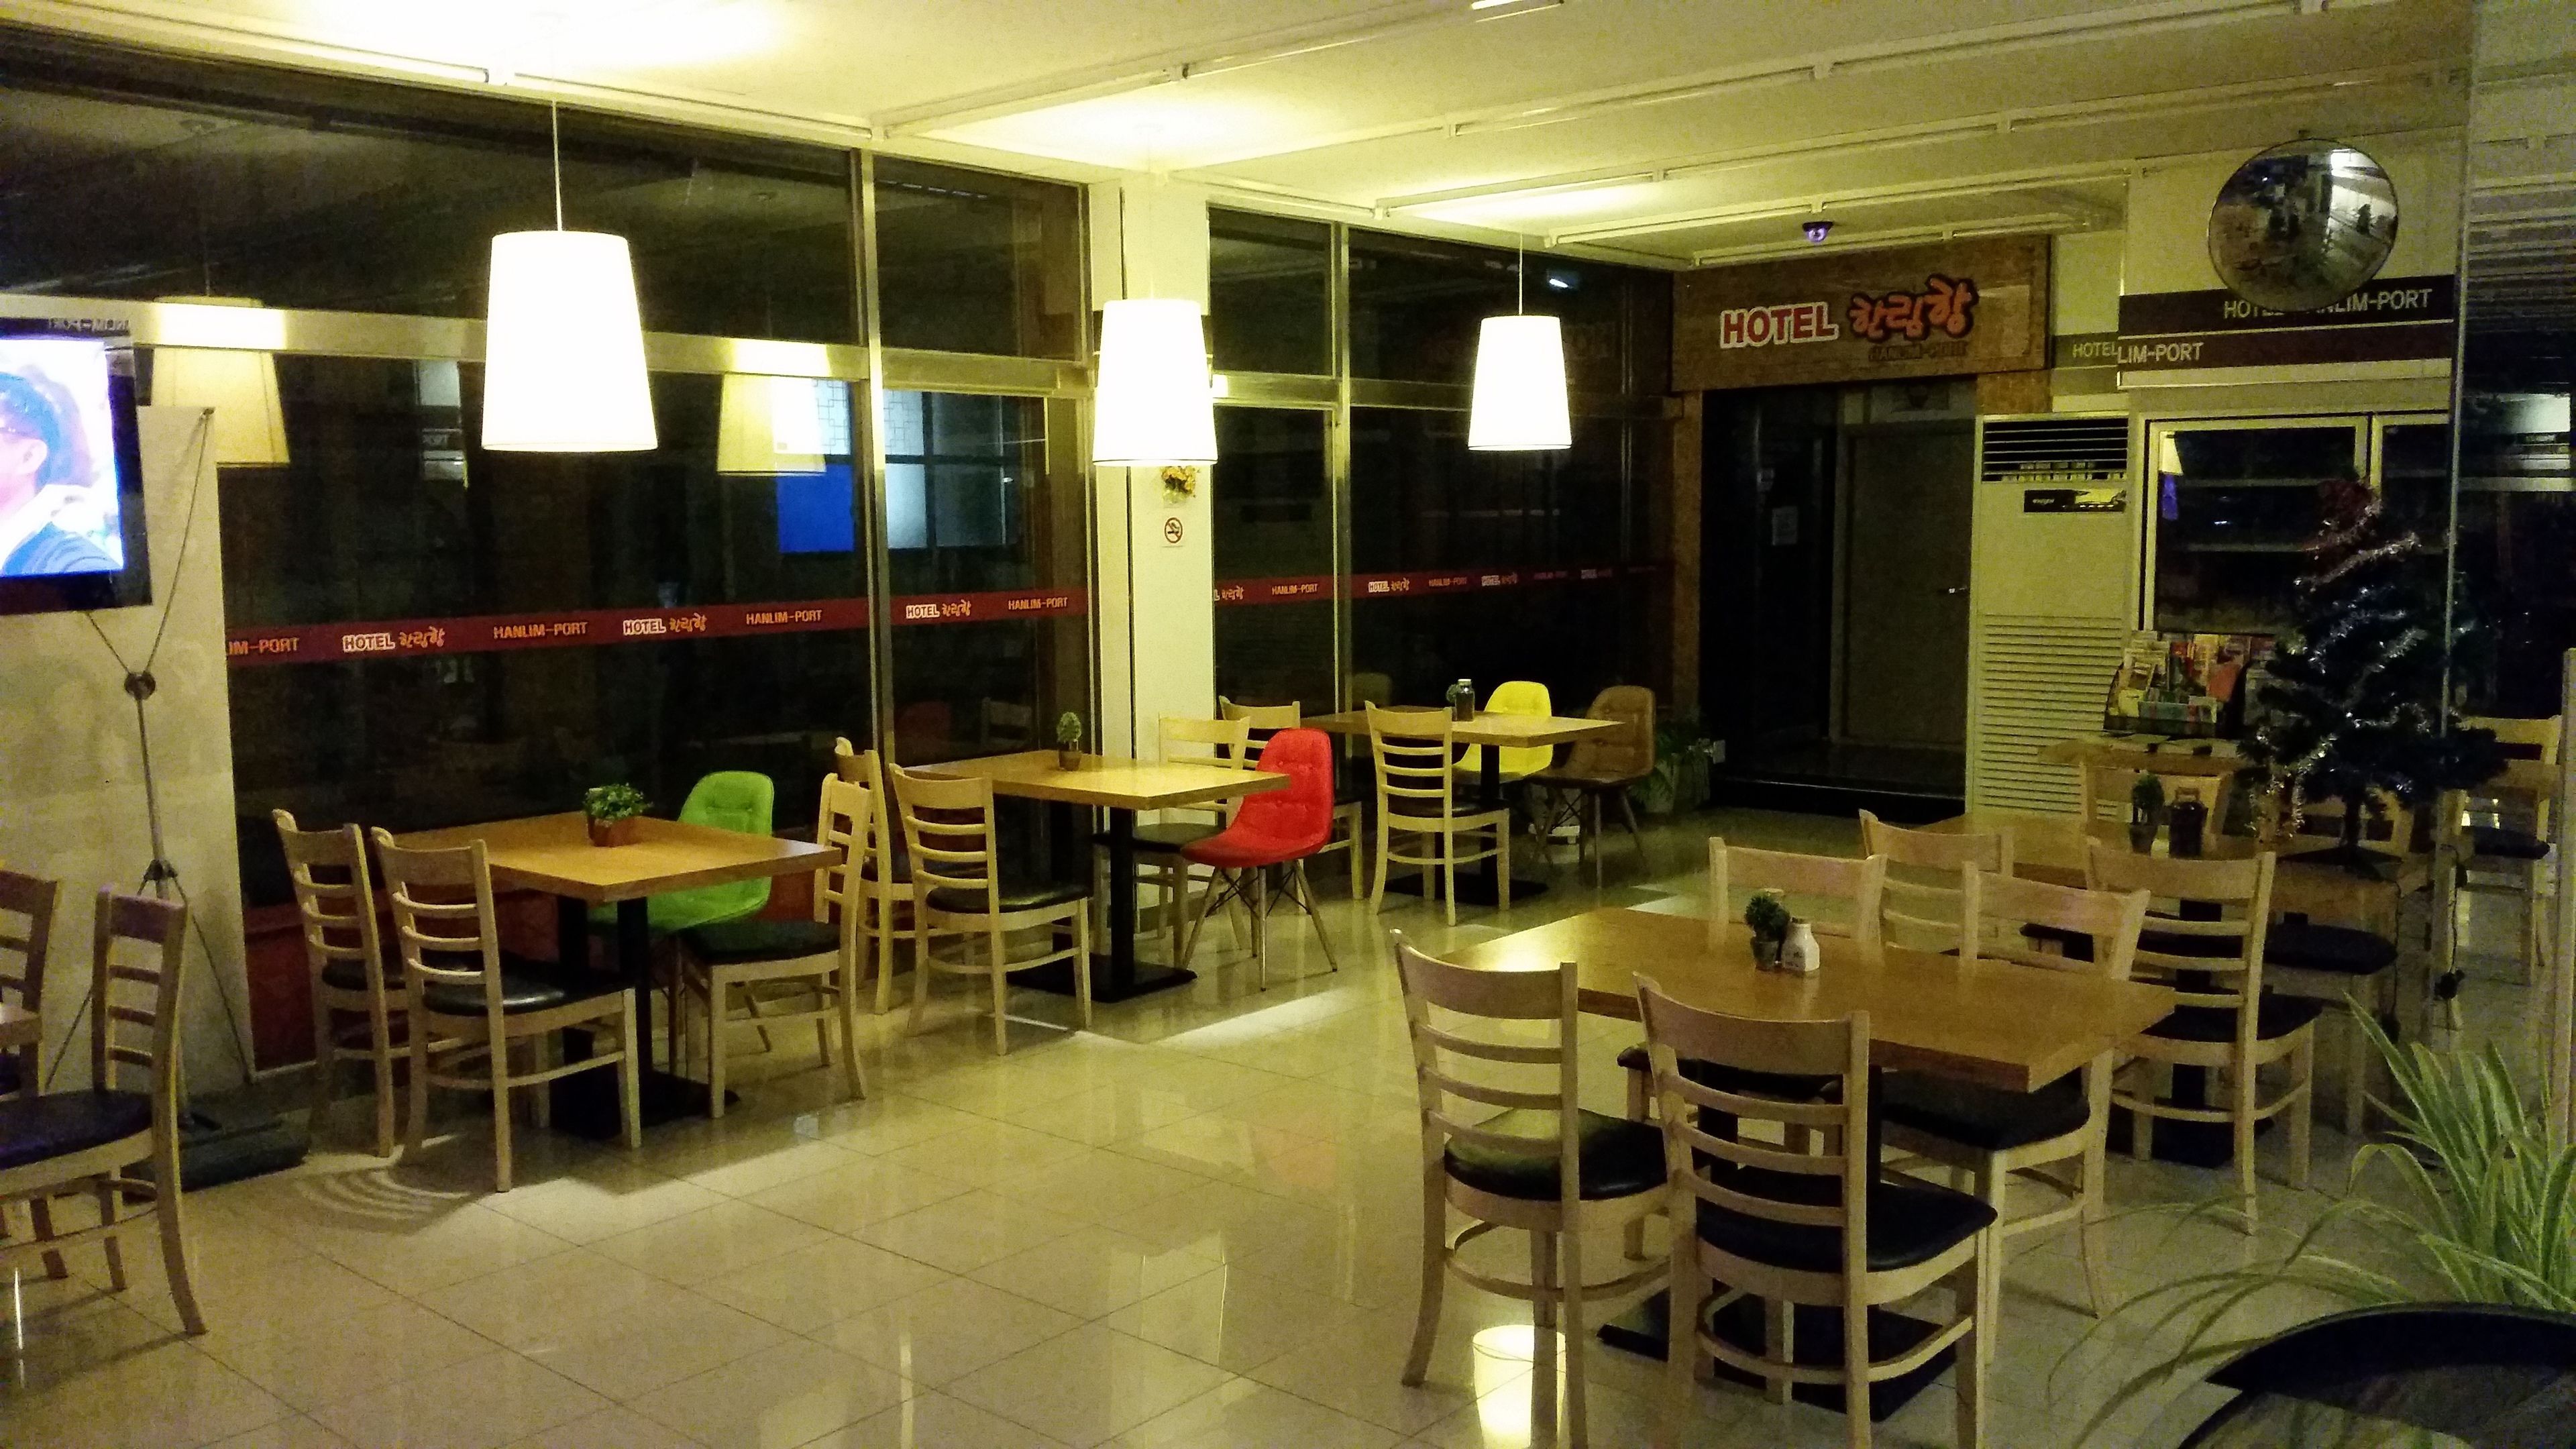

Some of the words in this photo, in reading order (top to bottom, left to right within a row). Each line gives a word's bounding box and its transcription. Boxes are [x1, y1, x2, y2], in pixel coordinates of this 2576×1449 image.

[2306, 288, 2432, 315] LIM-PORT
[1720, 301, 1839, 349] HOTEL
[2072, 341, 2118, 358] HOTEL
[1272, 583, 1318, 596] HANLIM-PORT
[1368, 580, 1390, 594] HOTEL
[906, 603, 940, 620] HOTEL
[1008, 596, 1068, 611] HANLIM-PORT
[746, 609, 822, 625] HANLIM-PORT
[493, 621, 588, 639] HANLIM-PORT
[623, 618, 666, 636] HOTEL
[342, 632, 396, 653] HOTEL
